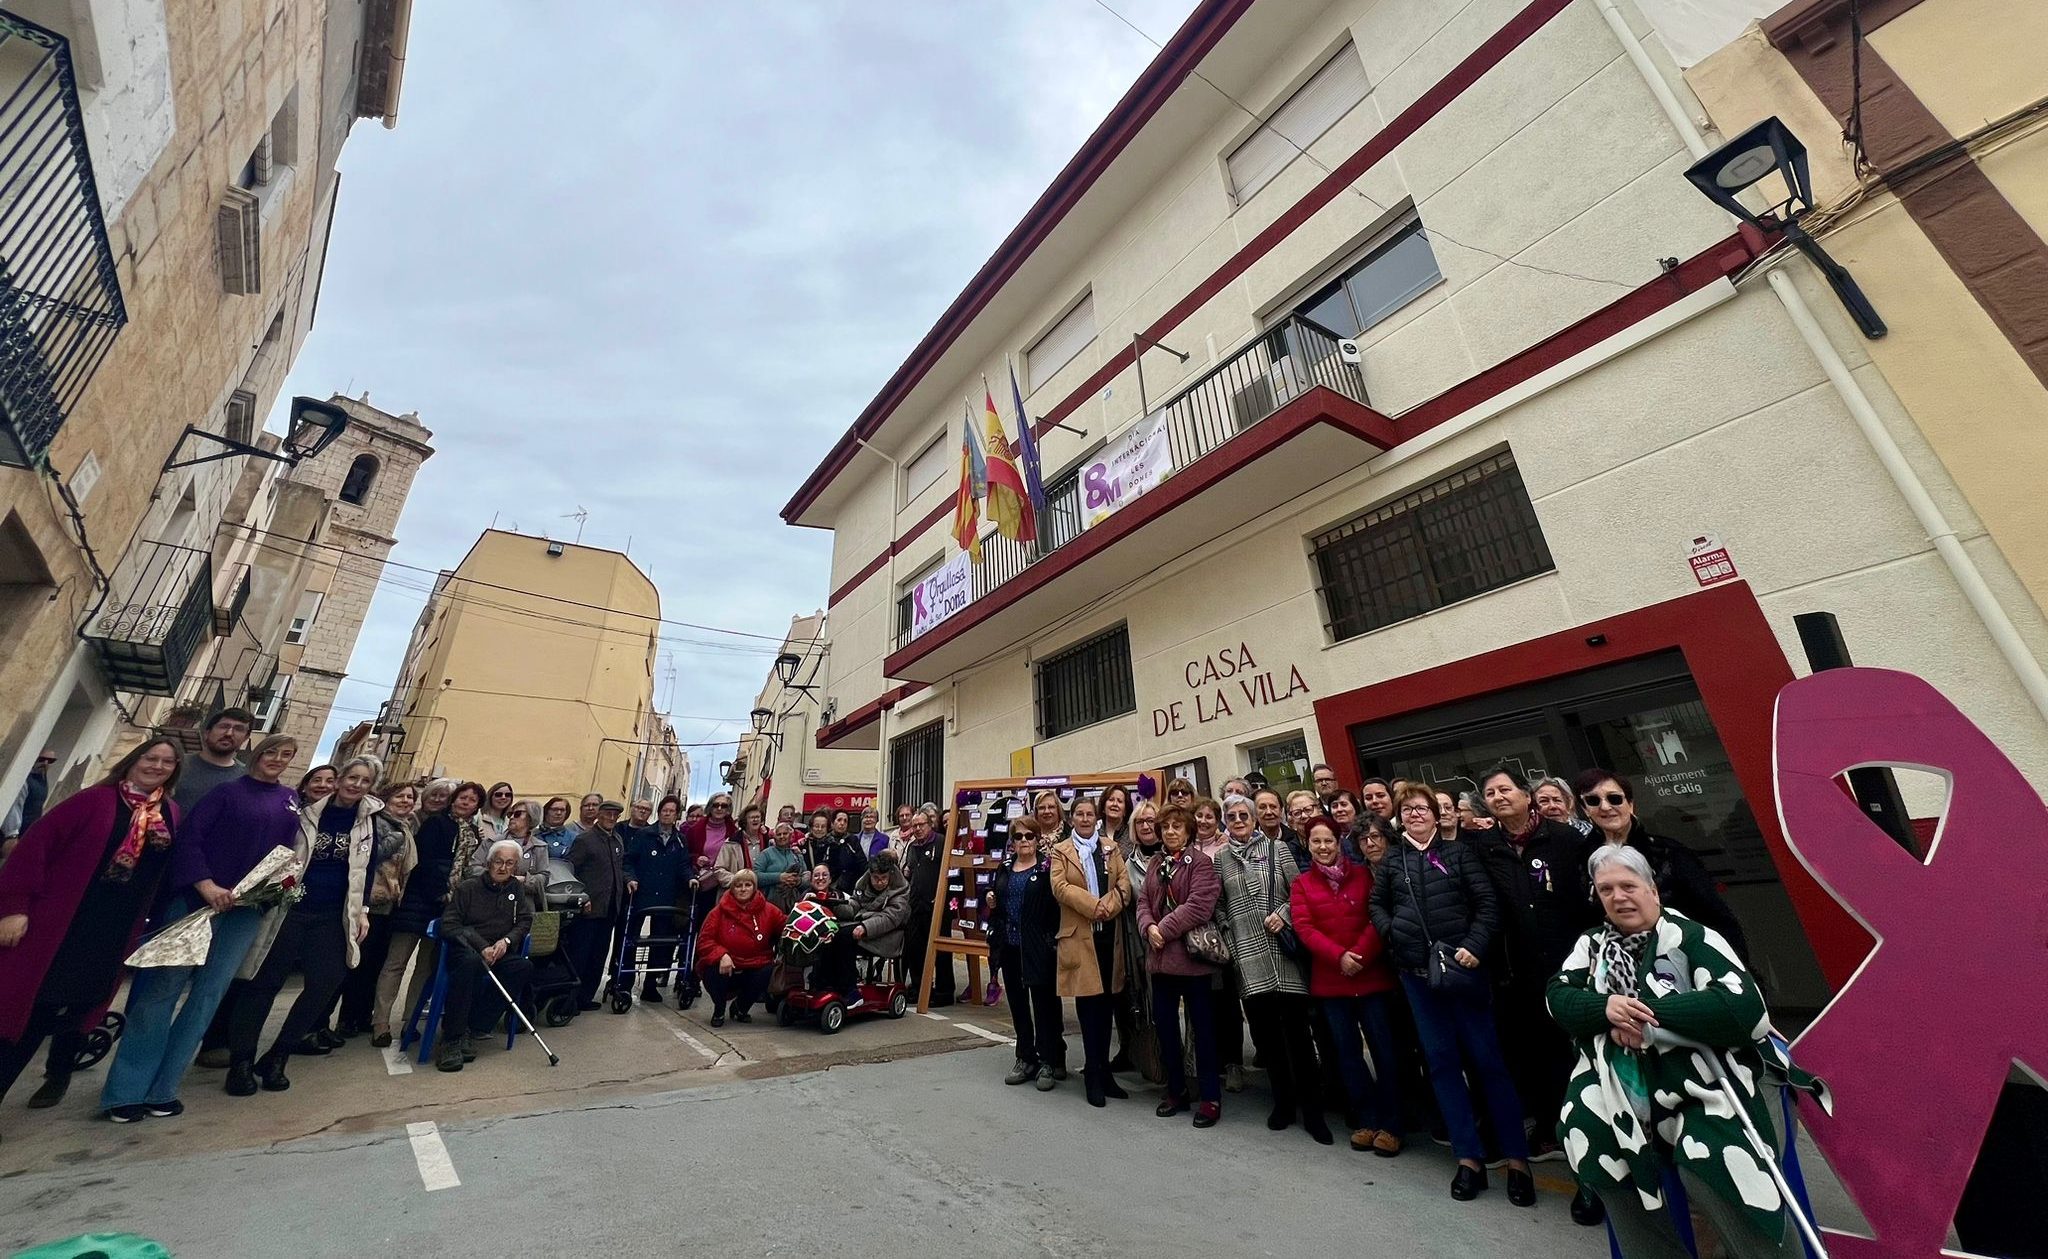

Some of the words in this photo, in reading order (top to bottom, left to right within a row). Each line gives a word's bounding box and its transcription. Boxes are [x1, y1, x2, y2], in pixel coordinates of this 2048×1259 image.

[1131, 462, 1145, 474] LES
[1128, 469, 1153, 488] DONES
[1693, 552, 1725, 566] Alarma
[1185, 641, 1257, 689] CASA
[1152, 701, 1186, 737] DE
[1195, 688, 1233, 723] LA
[1239, 663, 1310, 708] VILA
[1644, 769, 1706, 787] Ajuntament
[1657, 787, 1672, 797] de
[1673, 782, 1703, 795] Càlig
[850, 796, 877, 808] MA
